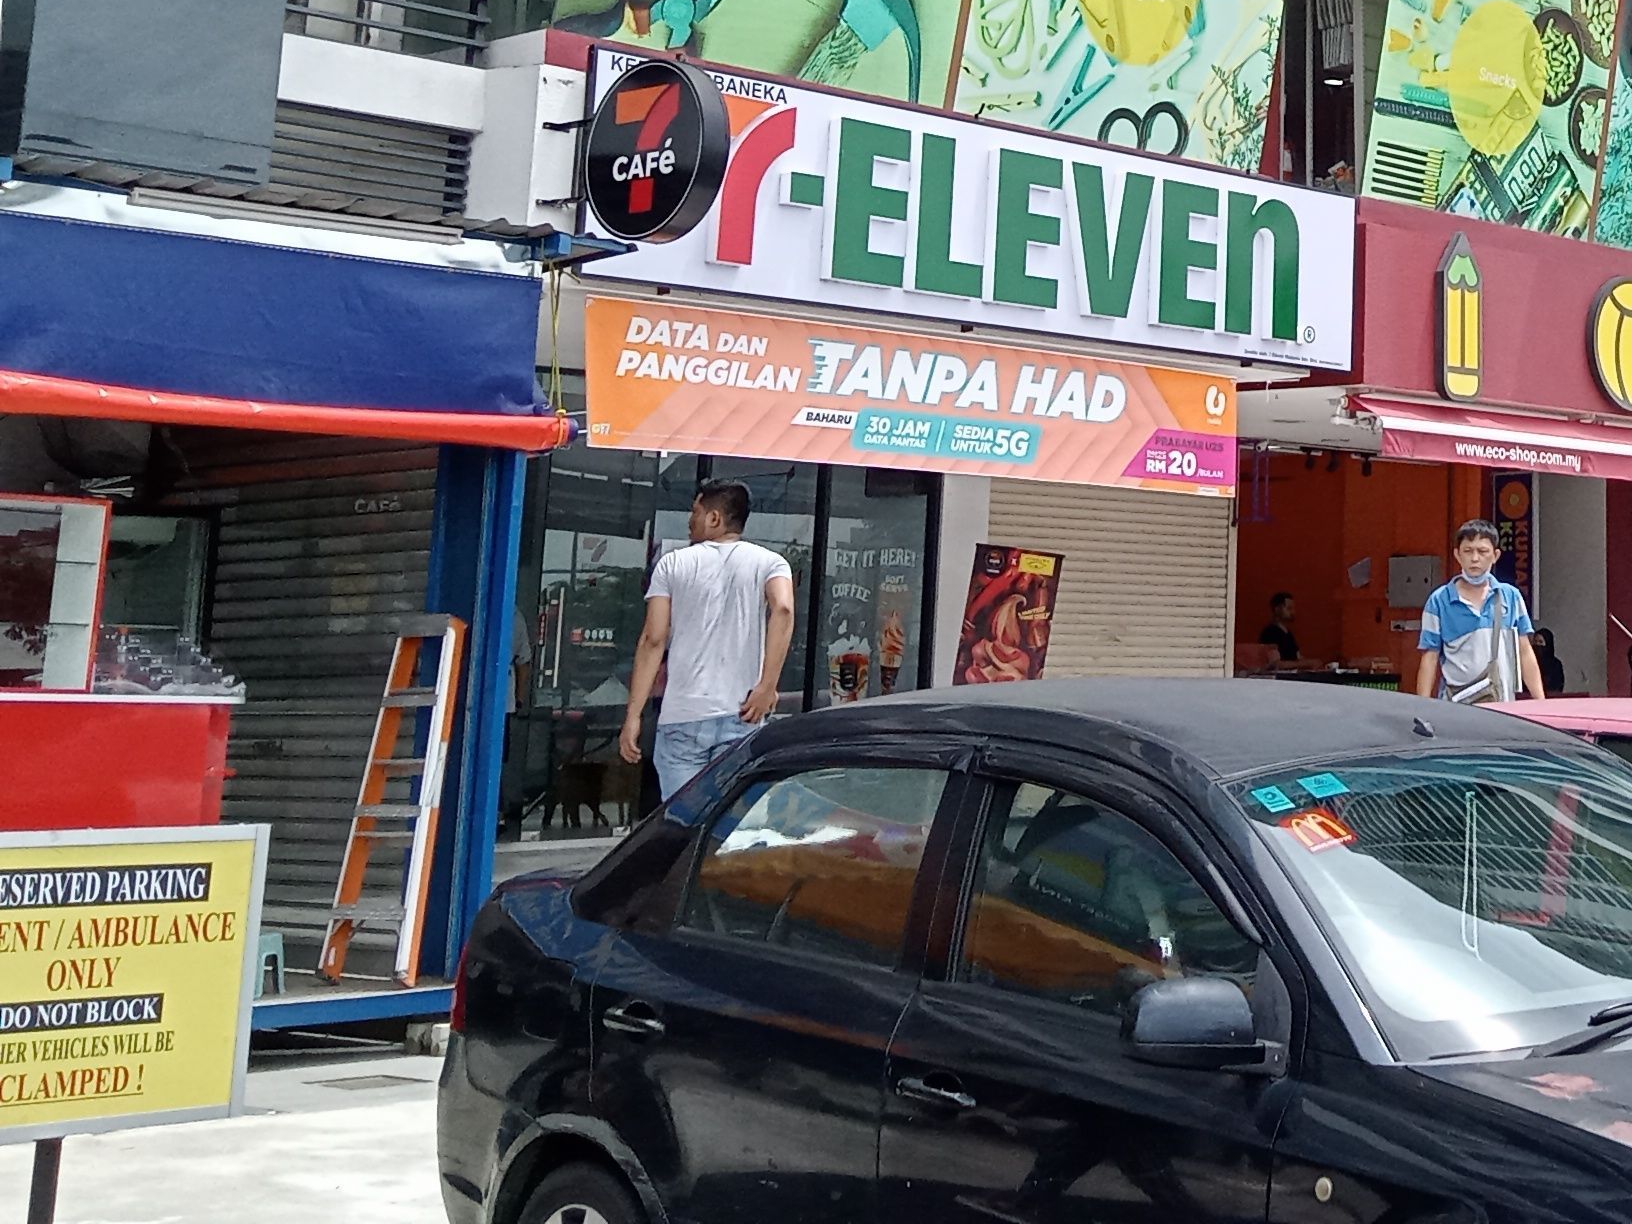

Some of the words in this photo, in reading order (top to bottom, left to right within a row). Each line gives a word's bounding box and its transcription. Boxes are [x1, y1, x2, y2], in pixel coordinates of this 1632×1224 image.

[712, 75, 788, 105] BANEKA
[1479, 66, 1518, 90] Snacks
[612, 137, 676, 182] CAFé
[625, 316, 710, 352] DATA
[715, 332, 768, 357] DAN
[615, 349, 802, 393] PANGGILAN
[807, 339, 1000, 412] TANPA
[1010, 364, 1128, 423] HAD
[805, 411, 853, 426] BAHARU
[866, 415, 890, 434] 30
[895, 418, 931, 437] JAM
[954, 425, 995, 442] SEDIA
[864, 434, 889, 447] DATA
[890, 436, 927, 449] PANTAS
[951, 439, 992, 454] UNTUK
[991, 430, 1029, 458] 5G
[1456, 441, 1581, 473] www.eco-shop.com.my
[1145, 458, 1168, 474] RM
[1167, 450, 1198, 477] 20
[834, 548, 859, 569] GET
[862, 549, 876, 568] IT
[879, 548, 916, 568] HERE!
[831, 582, 871, 603] COFFEE
[0, 871, 101, 907] ESERVED
[104, 867, 208, 902] PARKING
[0, 920, 51, 953] ENT
[67, 912, 237, 950] AMBULANCE
[47, 957, 122, 992] ONLY
[0, 1005, 32, 1028] DO
[36, 1001, 84, 1027] NOT
[86, 996, 161, 1023] BLOCK
[32, 1035, 110, 1062] VEHICLES
[113, 1032, 154, 1055] WILL
[155, 1030, 176, 1052] BE
[0, 1066, 130, 1103] CLAMPED
